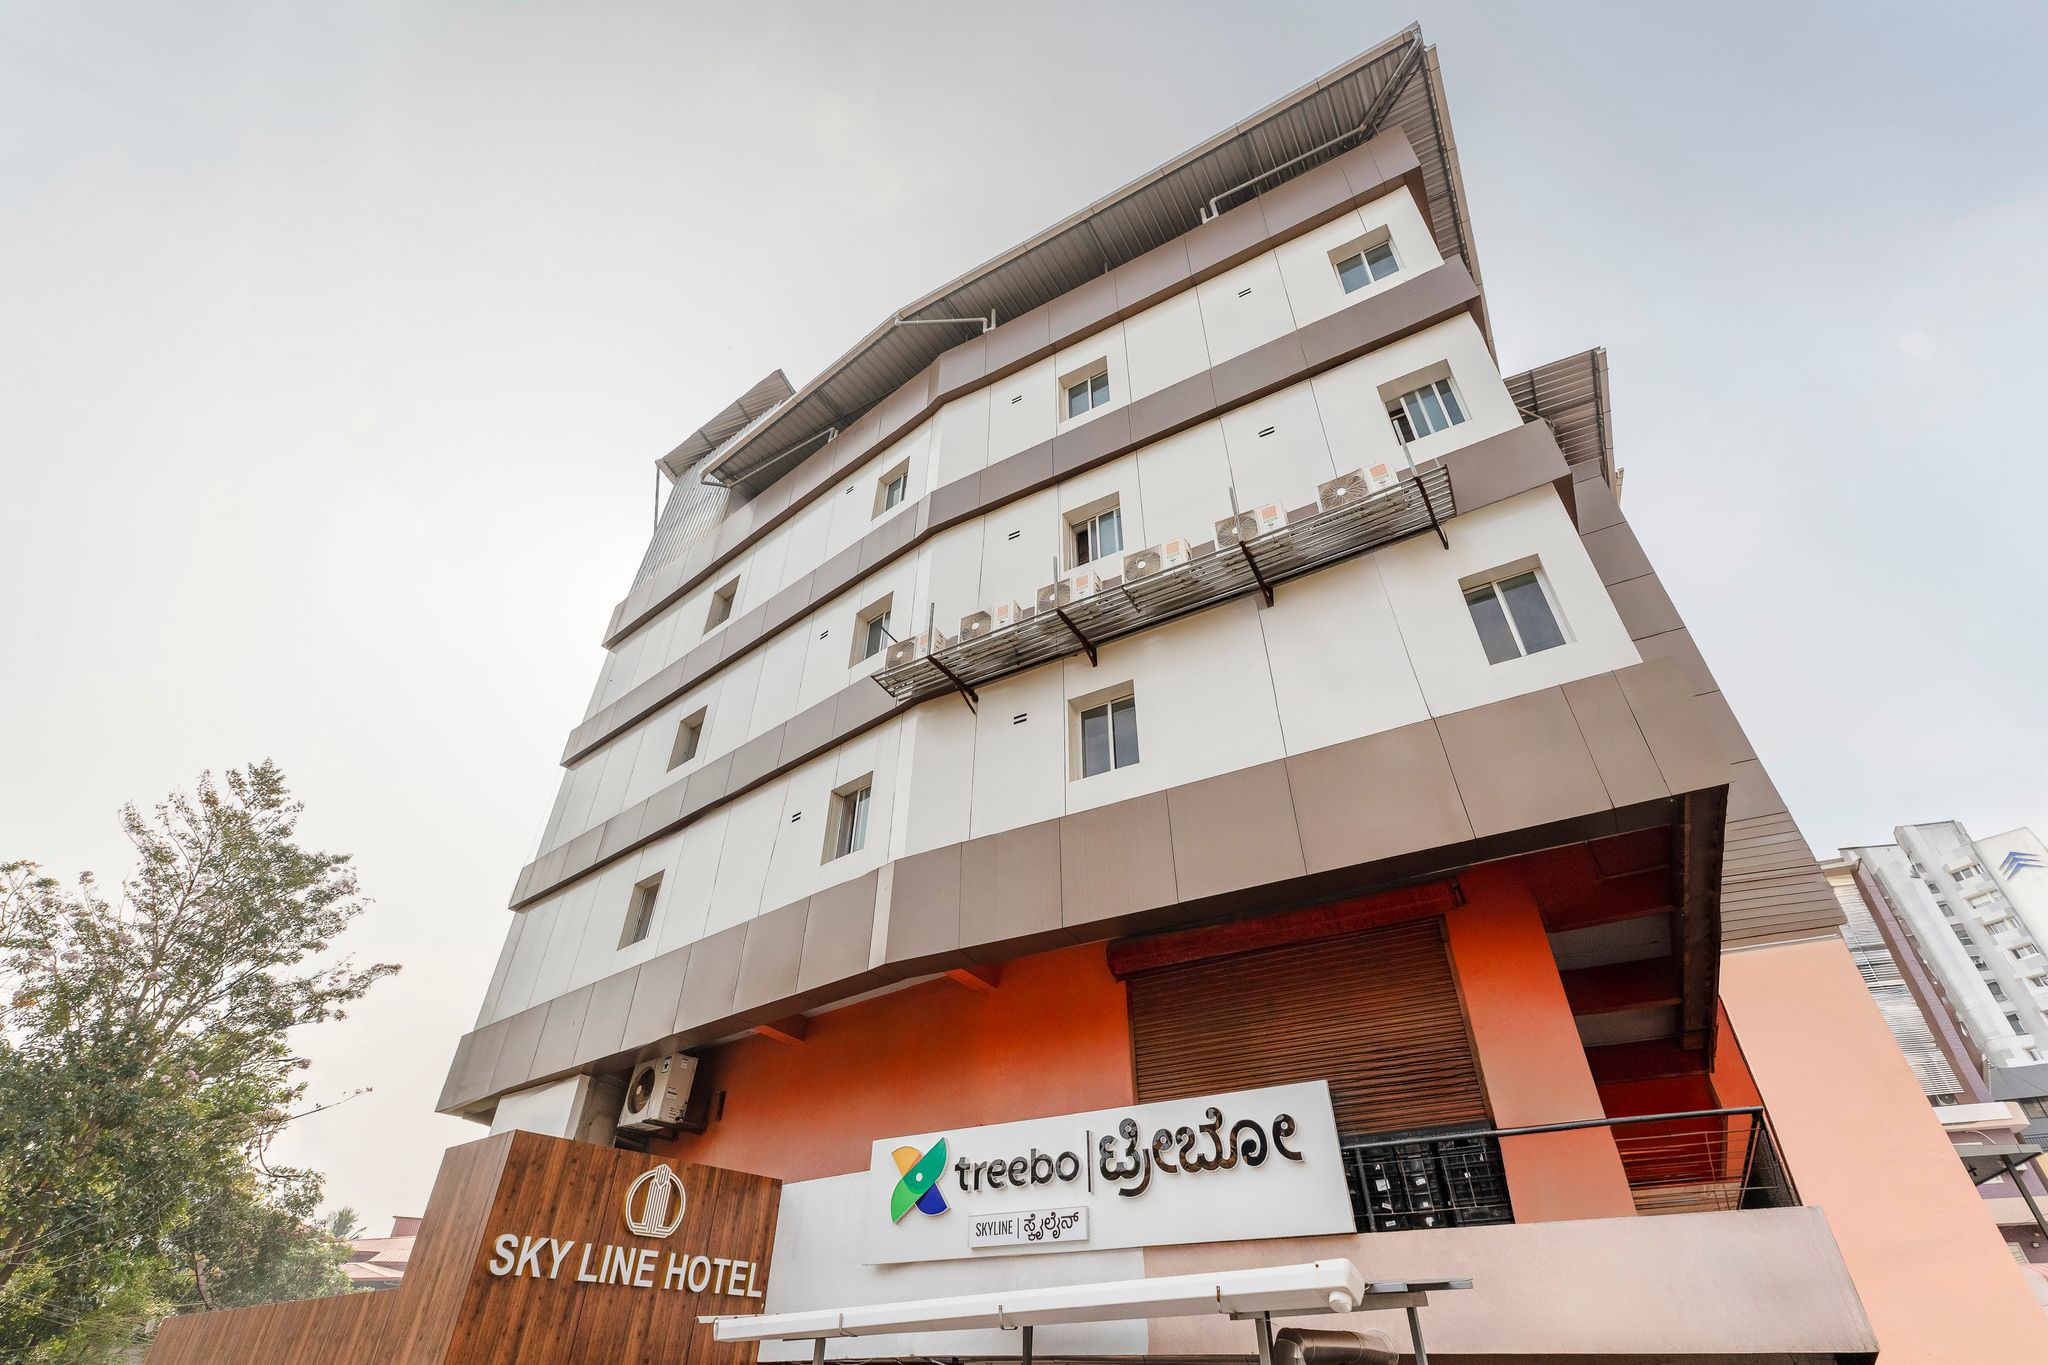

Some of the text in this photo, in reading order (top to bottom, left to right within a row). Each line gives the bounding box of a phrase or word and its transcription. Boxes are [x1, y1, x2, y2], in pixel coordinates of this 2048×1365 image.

[953, 1147, 1081, 1193] treebo
[975, 1219, 1014, 1238] SKYLINE
[489, 1233, 762, 1298] SKY LINE HOTEL
